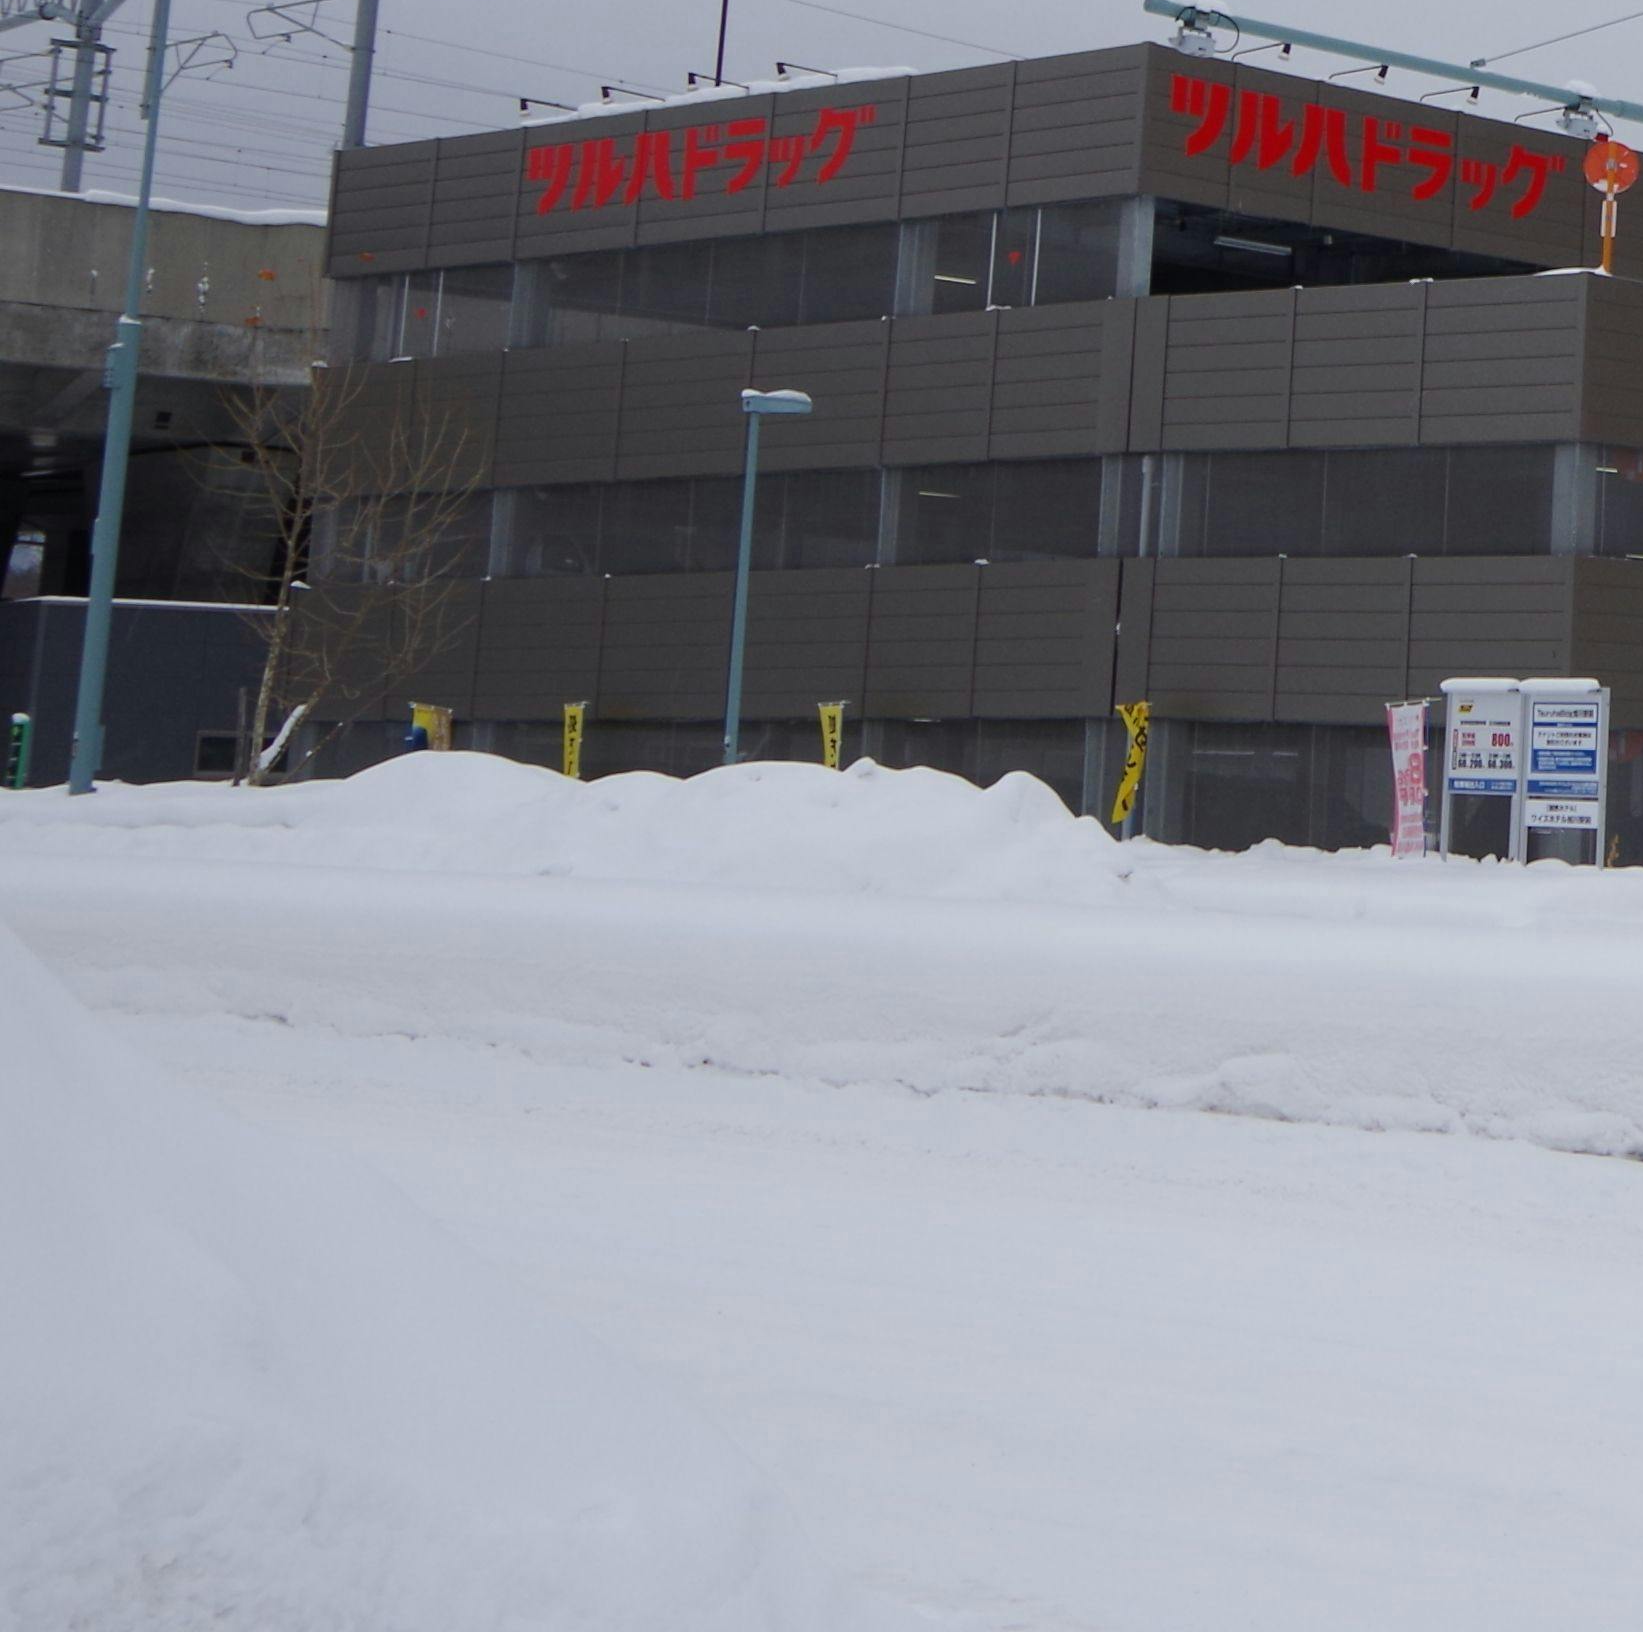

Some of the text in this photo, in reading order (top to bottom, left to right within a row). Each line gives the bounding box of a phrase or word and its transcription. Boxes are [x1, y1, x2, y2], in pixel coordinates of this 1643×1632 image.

[527, 104, 877, 216] ツルハドラッグ
[1169, 74, 1566, 219] ツルハドラッグ
